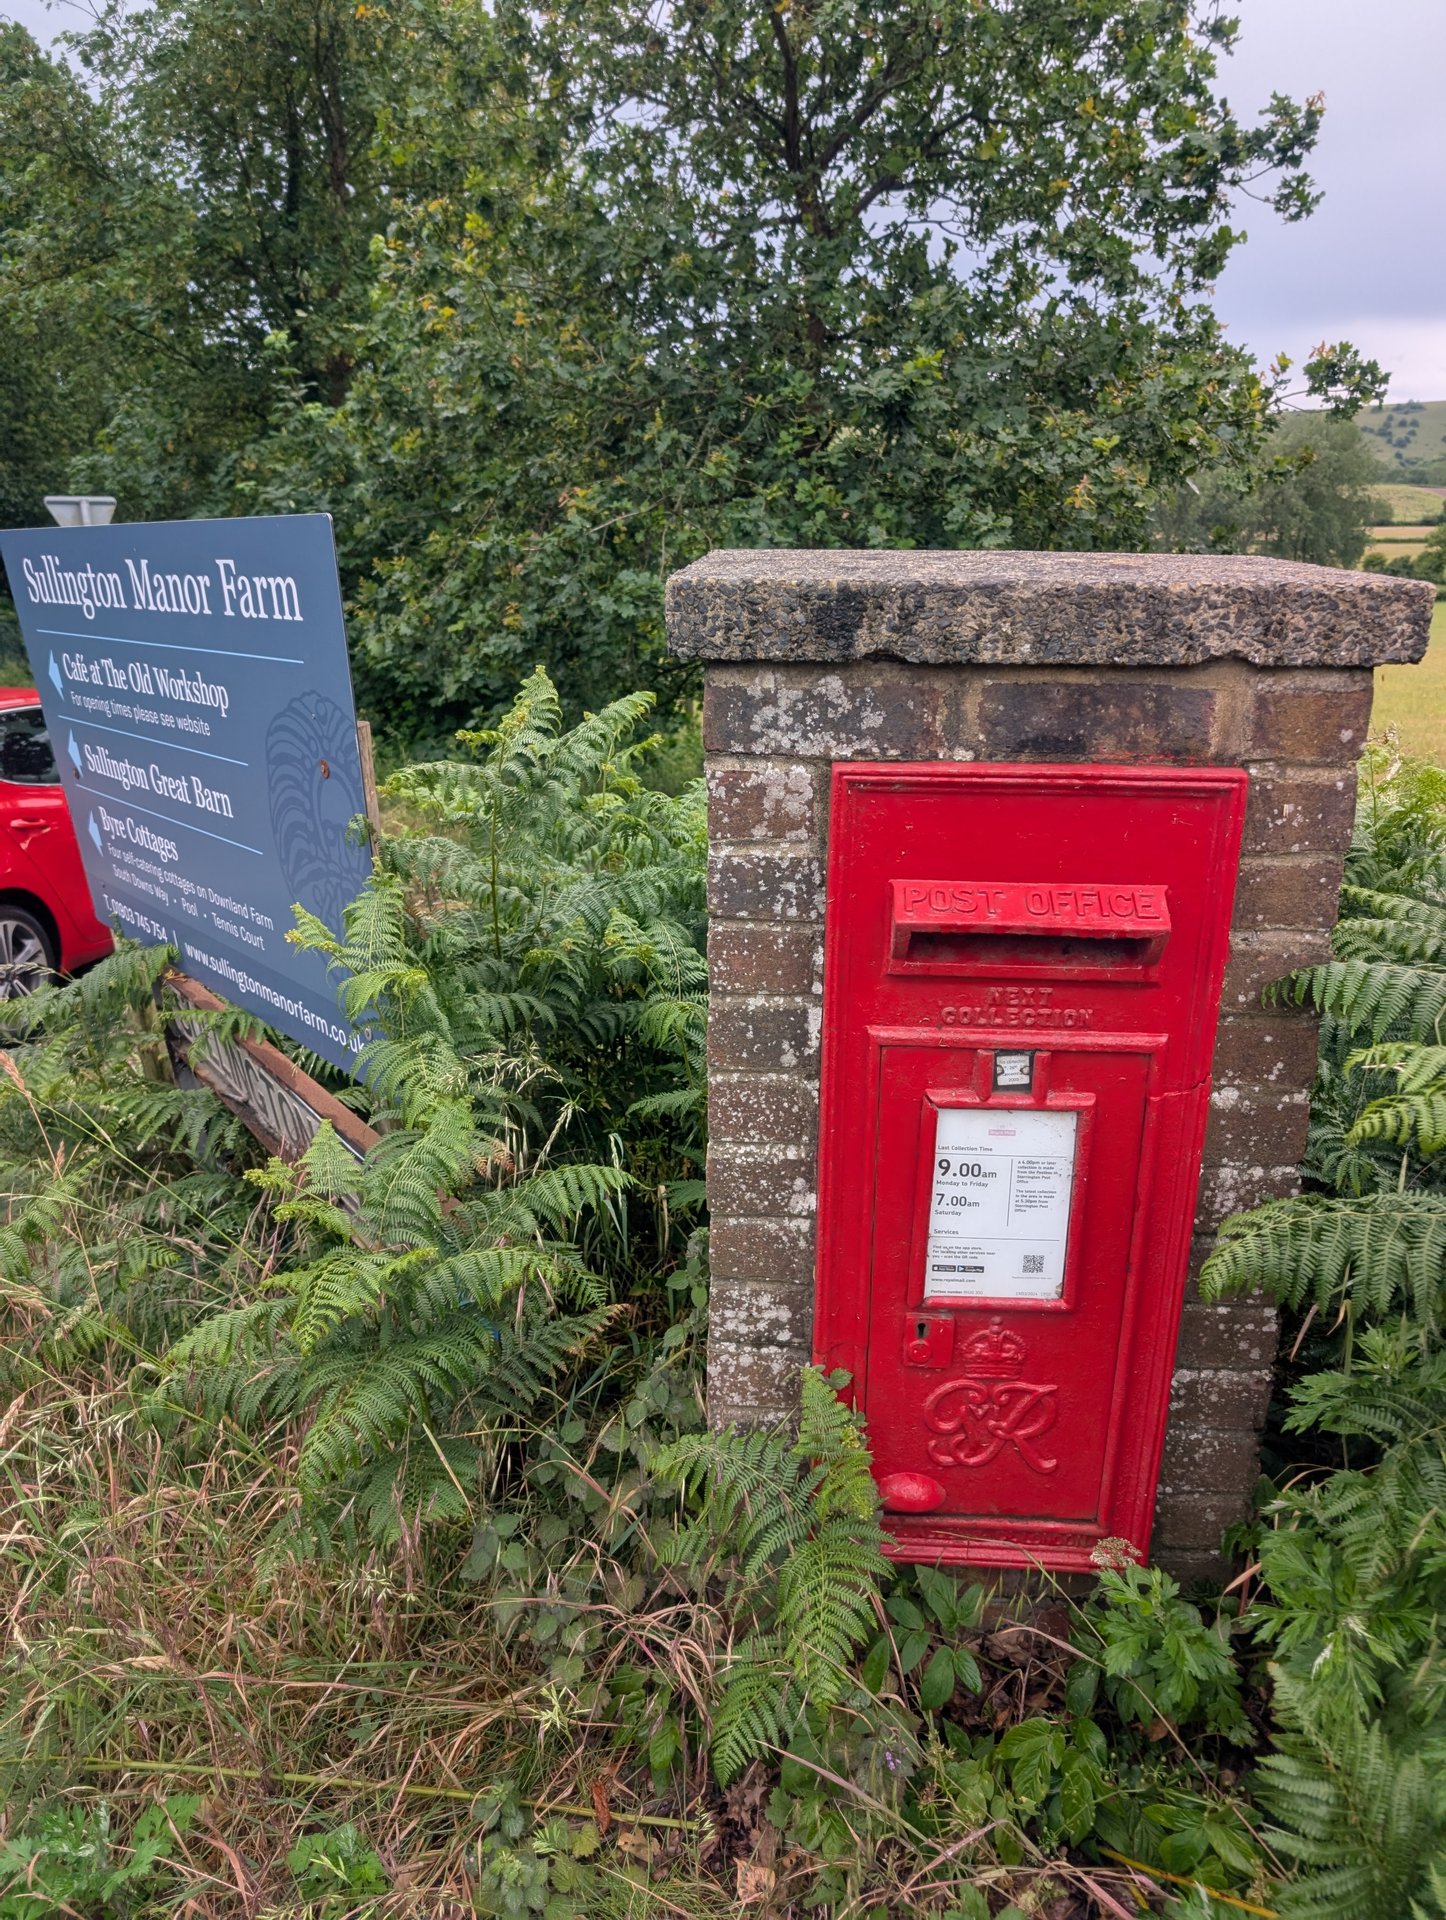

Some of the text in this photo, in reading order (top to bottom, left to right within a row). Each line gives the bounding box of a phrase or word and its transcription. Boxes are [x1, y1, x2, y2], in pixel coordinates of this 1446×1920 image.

[22, 554, 304, 622] Sullington Manor Farm
[62, 652, 229, 719] Café at The Old Workshop
[70, 690, 211, 737] For opening times please see website
[84, 743, 235, 819] Sullington Great Barn
[98, 806, 179, 863] Byre Cottages
[107, 842, 274, 931] Four self-catering cottages on Downland Farm
[902, 885, 1161, 920] POST OFFICE
[112, 863, 265, 951] South Downs Way Pool Tennis Court
[134, 911, 151, 934] 745
[150, 920, 168, 943] 754
[986, 986, 1055, 1007] NEXT
[940, 1006, 1094, 1029] COLLECTION
[936, 1180, 960, 1188] Monday
[938, 1158, 997, 1179] 9.00am
[934, 1208, 962, 1216] Saturday
[936, 1192, 980, 1208] 7.00am
